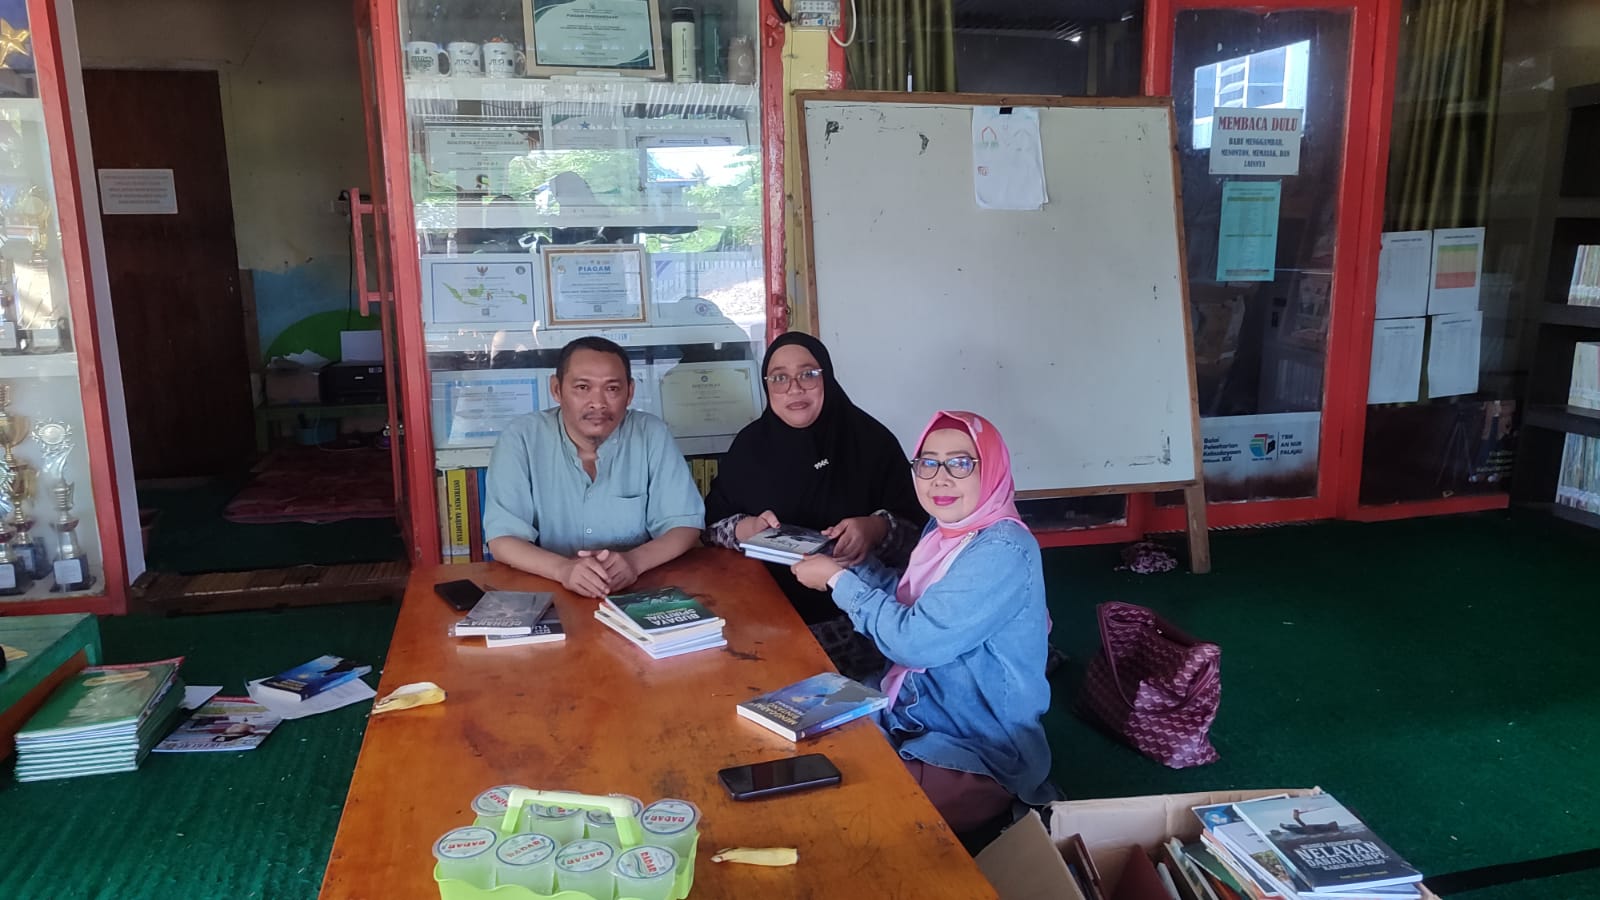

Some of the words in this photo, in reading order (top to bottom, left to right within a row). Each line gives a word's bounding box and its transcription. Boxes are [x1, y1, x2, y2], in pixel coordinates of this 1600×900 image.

[1218, 116, 1268, 131] MEMBACA
[1271, 117, 1298, 132] DULU
[643, 608, 697, 621] SPIRITUAL
[649, 613, 701, 626] BUDAYA
[650, 814, 686, 823] RADAR
[447, 840, 487, 849] RADAR
[505, 840, 542, 859] RADAR
[1293, 841, 1382, 860] NELAYAN
[566, 851, 605, 865] RADAR
[640, 851, 657, 873] RADAR
